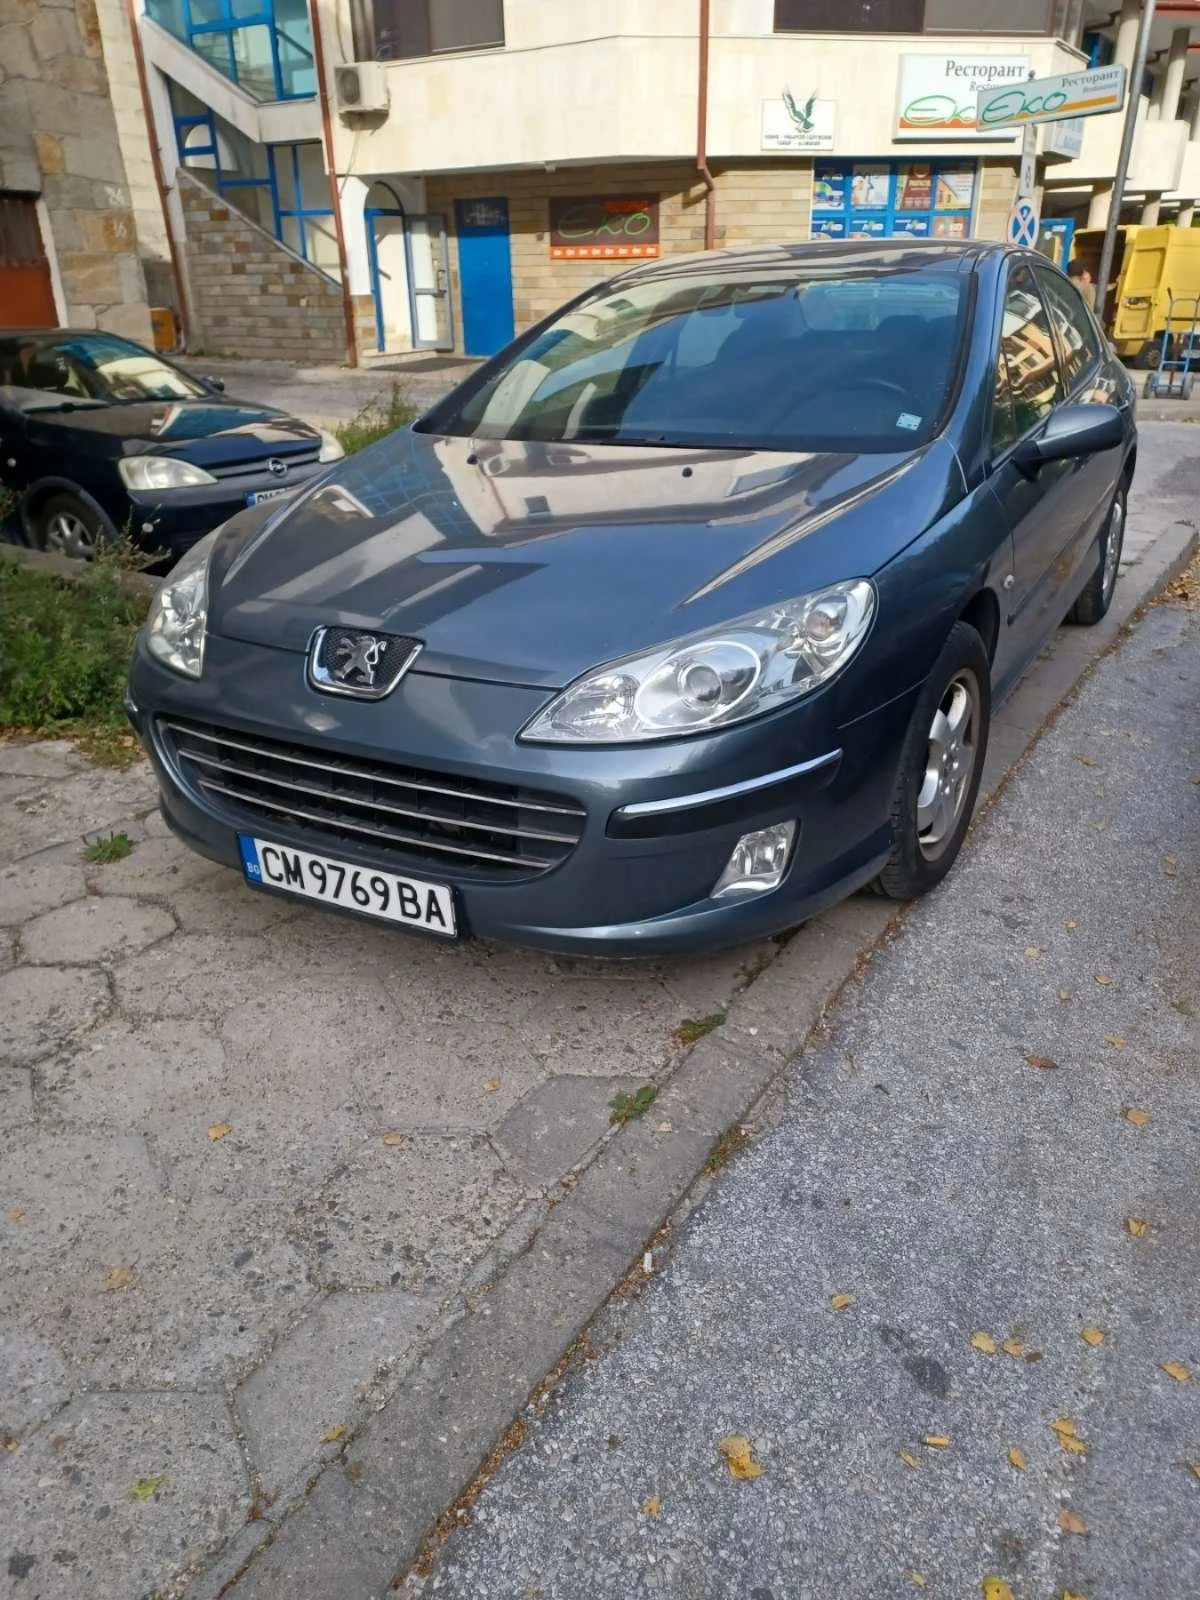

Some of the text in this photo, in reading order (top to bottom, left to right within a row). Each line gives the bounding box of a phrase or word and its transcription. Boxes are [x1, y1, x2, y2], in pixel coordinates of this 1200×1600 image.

[945, 60, 1025, 81] Ресторант
[1062, 71, 1120, 88] Ресторант
[904, 94, 976, 124] Ек
